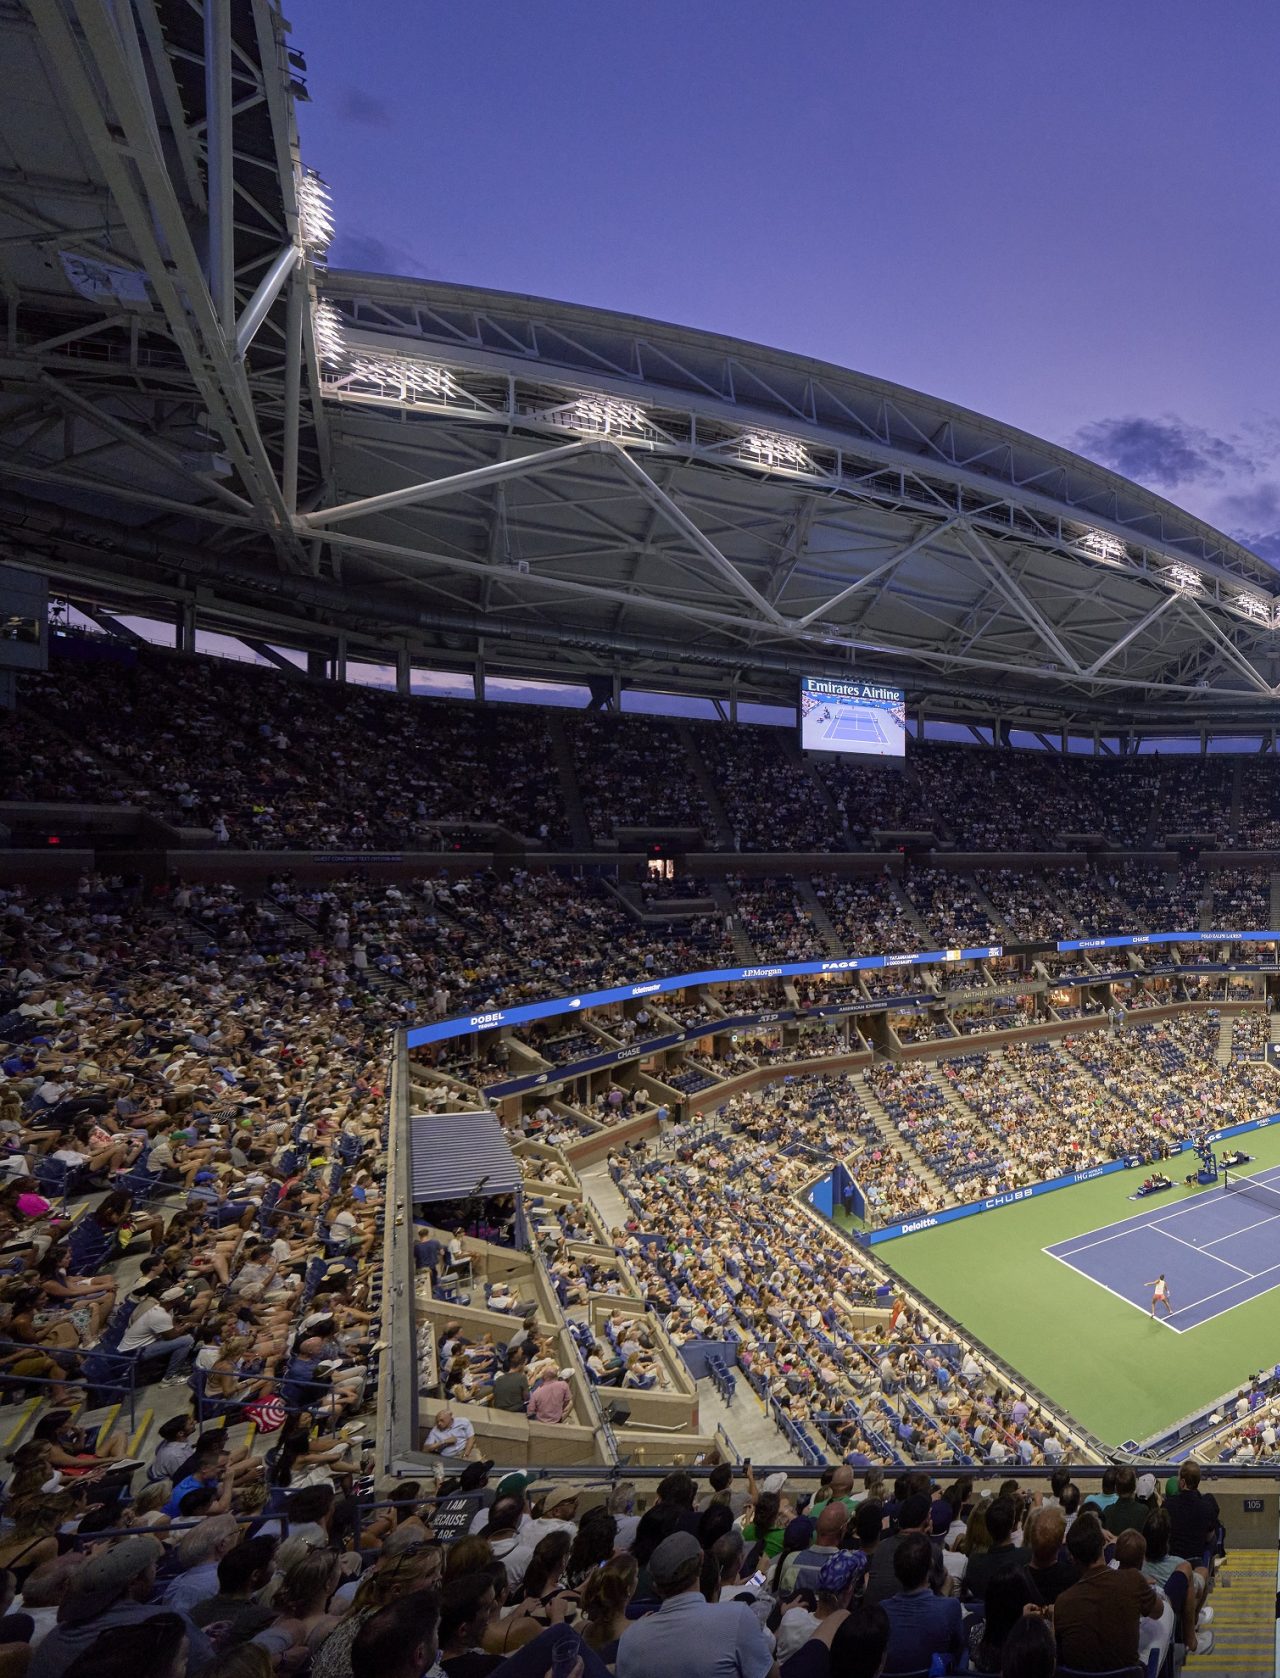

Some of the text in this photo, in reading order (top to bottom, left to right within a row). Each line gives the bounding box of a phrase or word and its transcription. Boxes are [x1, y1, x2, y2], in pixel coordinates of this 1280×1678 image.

[808, 679, 900, 701] Emirates Airline
[822, 961, 858, 970] FAGE
[742, 968, 782, 978] J.P.Morgan
[963, 990, 988, 999] ARTHUR
[838, 1002, 888, 1012] AMERICAN EXPRESS
[470, 1012, 505, 1026] DOBEL
[478, 1022, 498, 1030] TEQUILA
[617, 1046, 641, 1060] CHASE
[1074, 1171, 1088, 1182] IHG
[986, 1188, 1033, 1208] CHUBB
[902, 1217, 938, 1234] Deloitte.
[446, 1499, 467, 1511] I AM
[1247, 1500, 1261, 1510] 105
